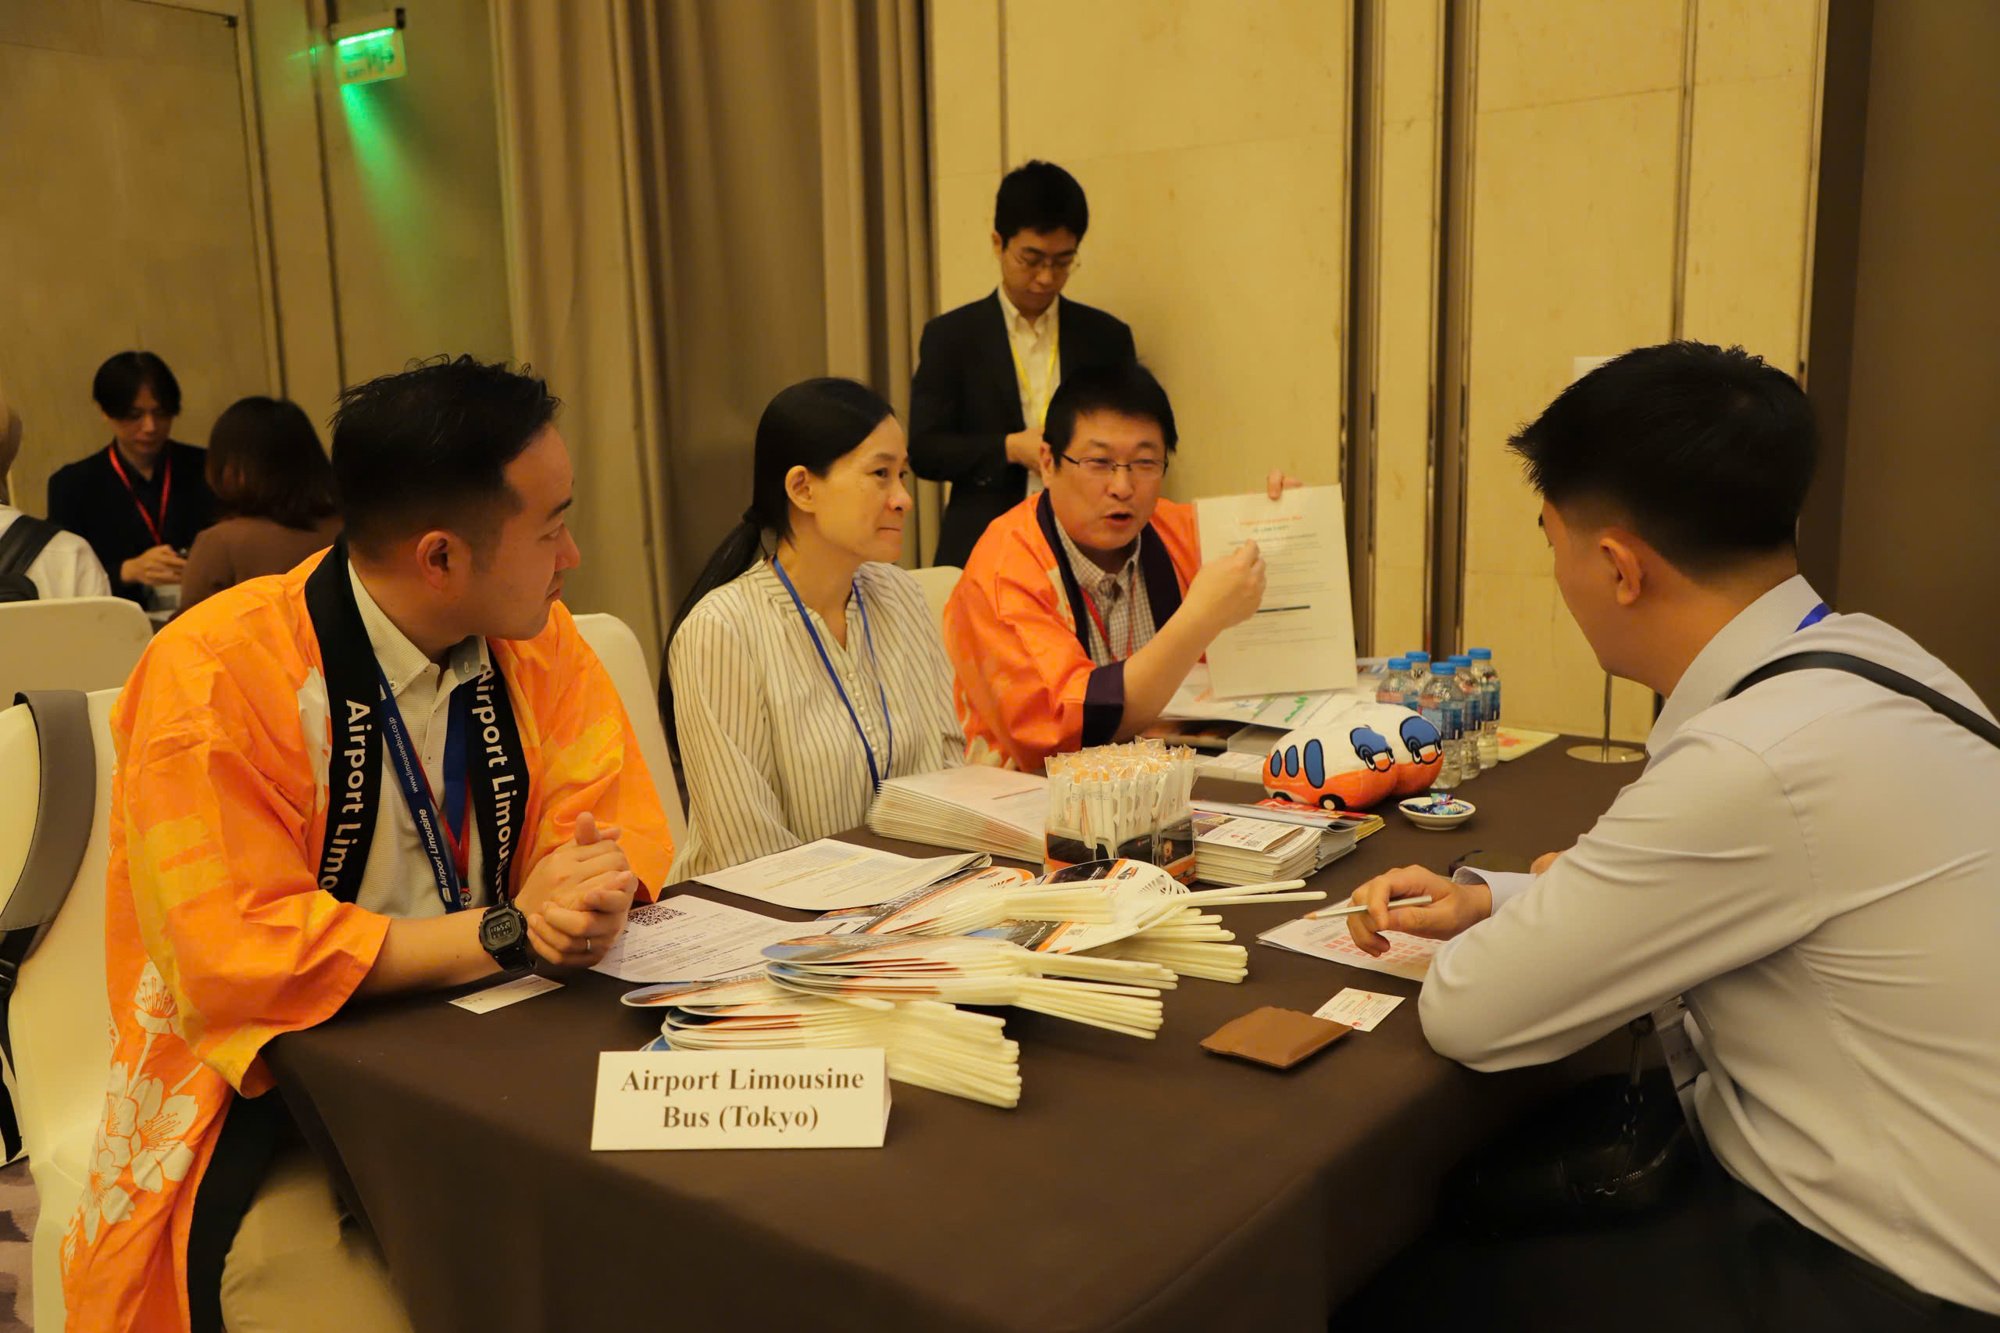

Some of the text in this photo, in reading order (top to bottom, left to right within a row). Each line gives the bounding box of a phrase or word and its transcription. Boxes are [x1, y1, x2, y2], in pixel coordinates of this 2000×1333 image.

[342, 700, 372, 813] Airport
[472, 667, 508, 768] Airport
[418, 808, 449, 887] Airport Limousine
[620, 1068, 864, 1097] Airport Limousine
[662, 1105, 819, 1133] Bus (Tokyo)
